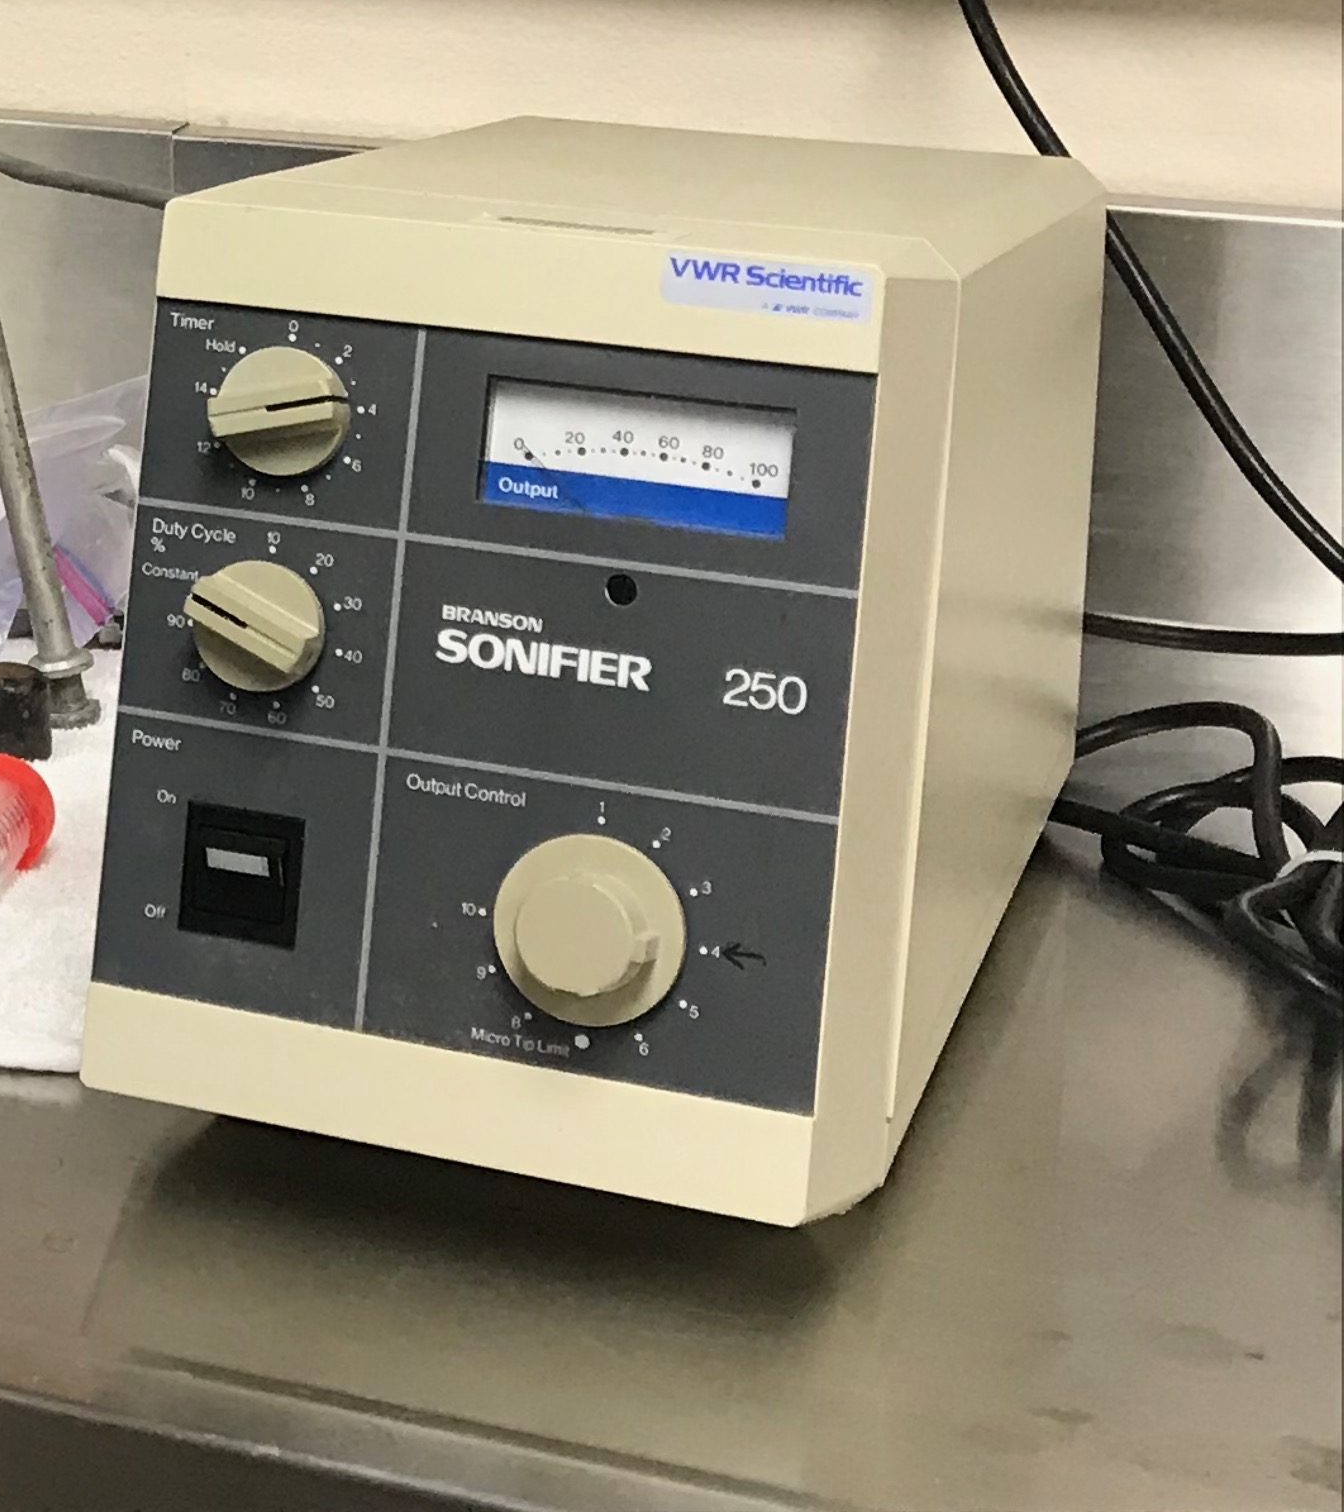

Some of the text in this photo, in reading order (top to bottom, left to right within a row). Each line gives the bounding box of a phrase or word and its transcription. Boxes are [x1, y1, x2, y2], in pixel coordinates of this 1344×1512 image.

[670, 257, 863, 297] VWR Scientific
[170, 312, 214, 330] Timer
[288, 320, 299, 331] 0
[205, 338, 235, 353] Hold
[343, 345, 352, 357] 2
[195, 381, 207, 393] 14
[368, 404, 376, 415] 4
[513, 437, 524, 451] 0
[565, 432, 586, 445] 20
[612, 430, 634, 444] 40
[658, 436, 680, 451] 60
[197, 441, 210, 454] 12
[701, 445, 724, 460] 80
[351, 460, 362, 472] 6
[749, 462, 779, 478] 100
[241, 488, 255, 500] 10
[498, 477, 559, 500] Output
[305, 493, 315, 506] 8
[152, 518, 236, 544] Duty Cycle
[267, 531, 280, 545] 10
[150, 537, 166, 553] %
[315, 553, 334, 568] 20
[141, 561, 199, 583] Constant
[343, 597, 362, 611] 30
[166, 614, 185, 628] 90
[441, 604, 543, 633] BRANSON
[344, 650, 362, 664] 40
[435, 628, 652, 692] SONIFIER
[182, 668, 200, 682] 80
[722, 668, 808, 715] 250
[219, 701, 236, 715] 70
[315, 695, 335, 709] 50
[267, 711, 287, 725] 60
[132, 729, 181, 751] Power
[406, 772, 526, 808] Output Control
[157, 790, 176, 805] On
[599, 801, 605, 813] 1
[660, 827, 672, 841] 2
[701, 882, 712, 895] 3
[461, 902, 476, 916] 10
[711, 946, 721, 957] 4
[476, 967, 486, 980] 9
[689, 1006, 700, 1020] 5
[471, 1027, 511, 1047] Micro
[537, 1040, 571, 1058] Limit
[638, 1042, 649, 1056] 6
